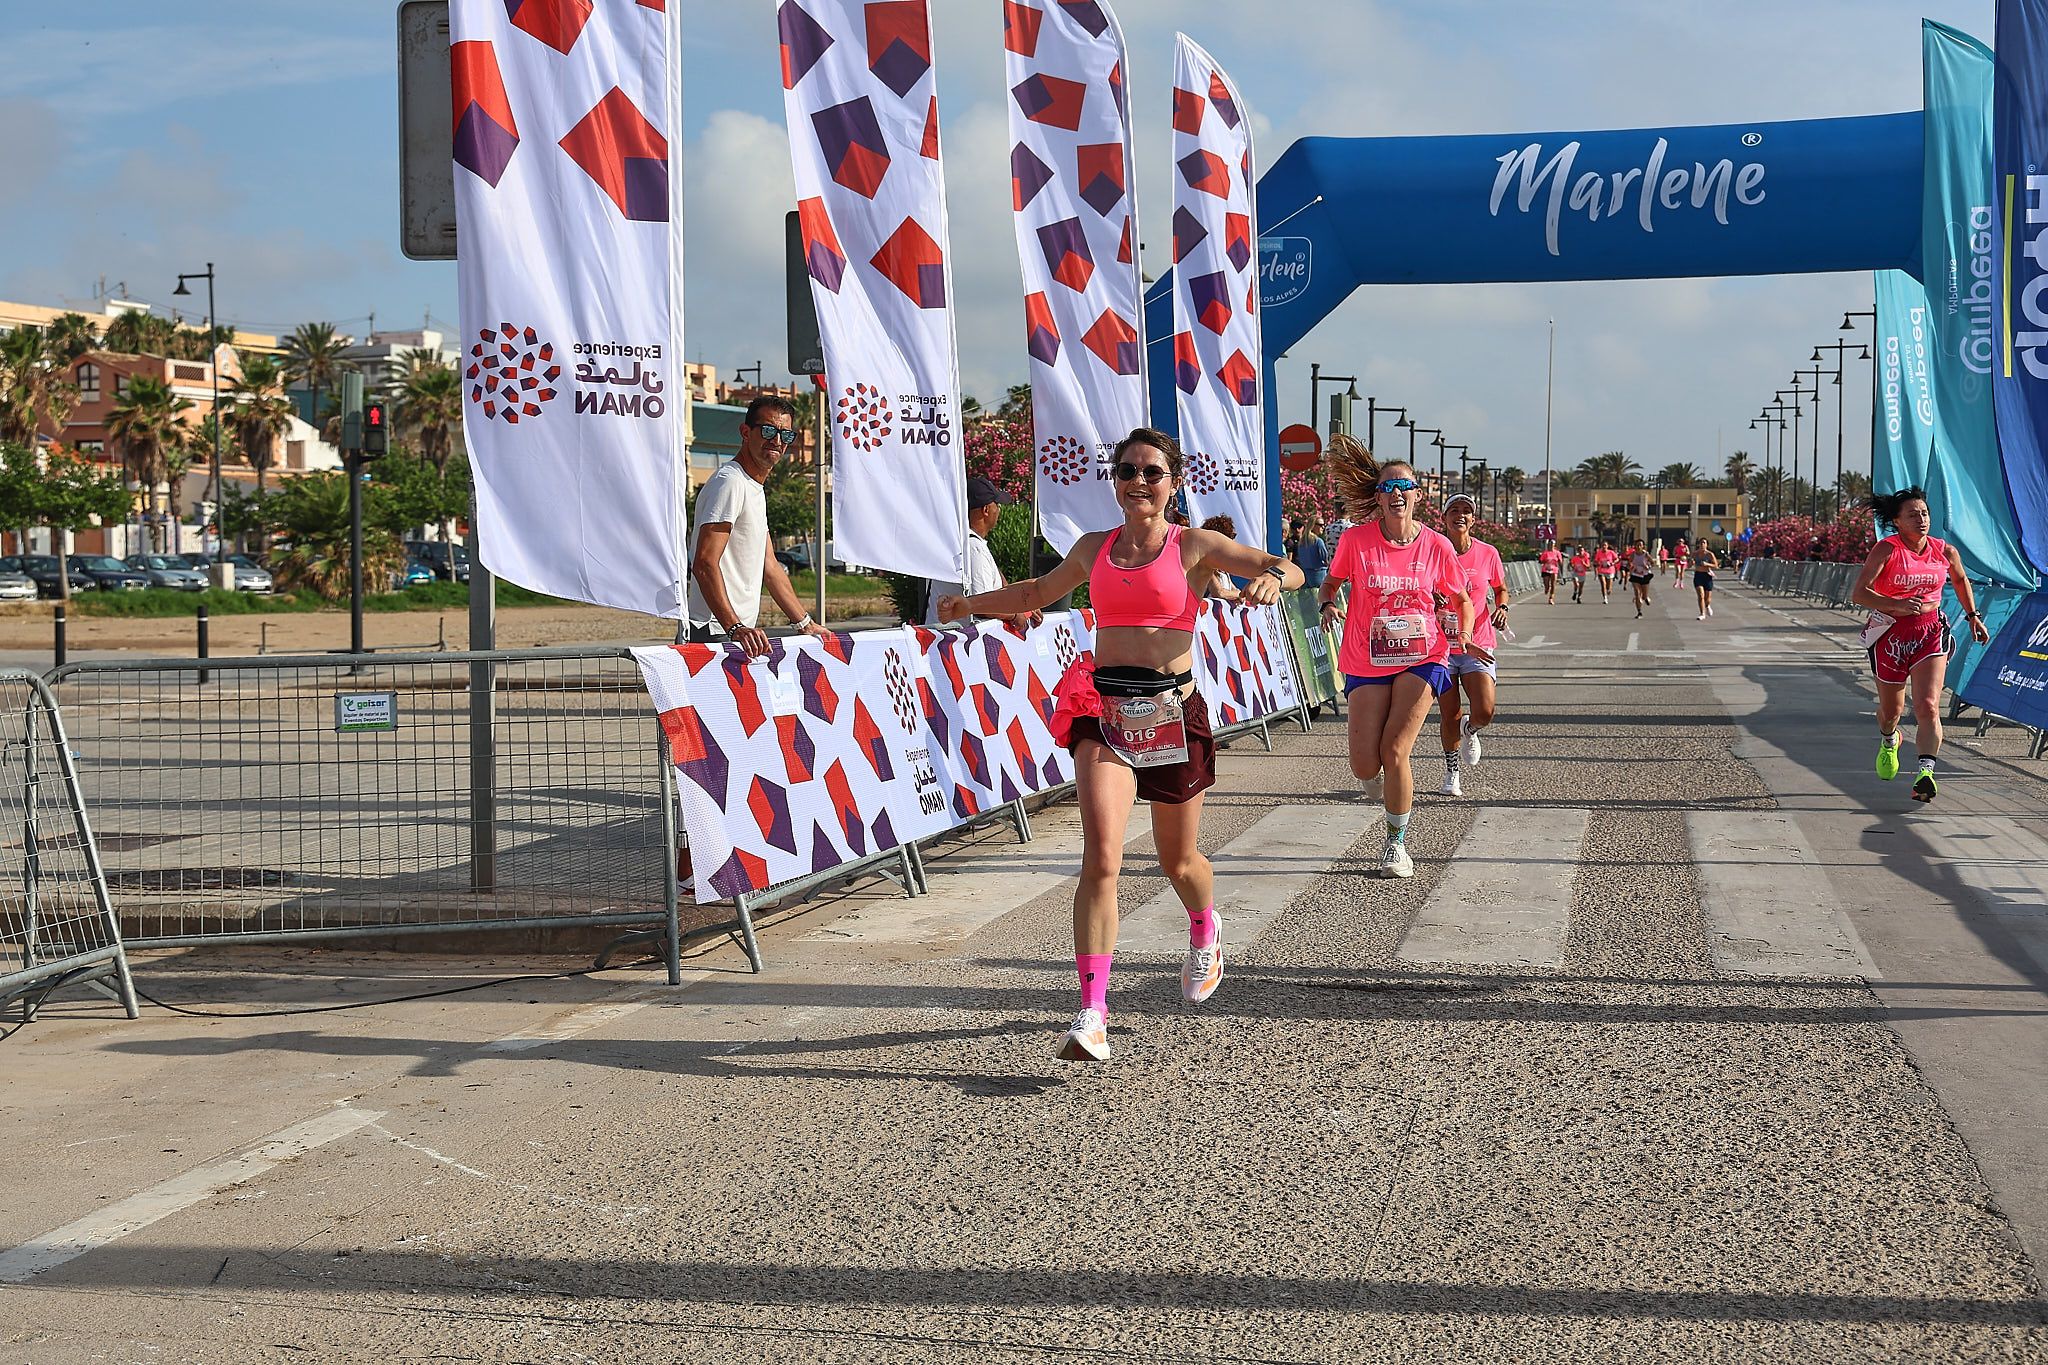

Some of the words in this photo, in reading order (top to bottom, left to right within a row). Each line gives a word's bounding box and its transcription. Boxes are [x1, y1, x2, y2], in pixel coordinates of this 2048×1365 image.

[1489, 136, 1766, 256] Marlene
[1259, 252, 1305, 282] rlene
[1276, 286, 1299, 302] ALPES
[1368, 574, 1421, 591] CARRERA
[1894, 573, 1939, 586] CARRERA
[1388, 638, 1410, 648] 016
[1123, 728, 1156, 742] 016
[1156, 743, 1177, 751] VALENCIA
[904, 747, 930, 764] Experience
[1150, 753, 1178, 762] Santander
[919, 790, 945, 815] OMAN
